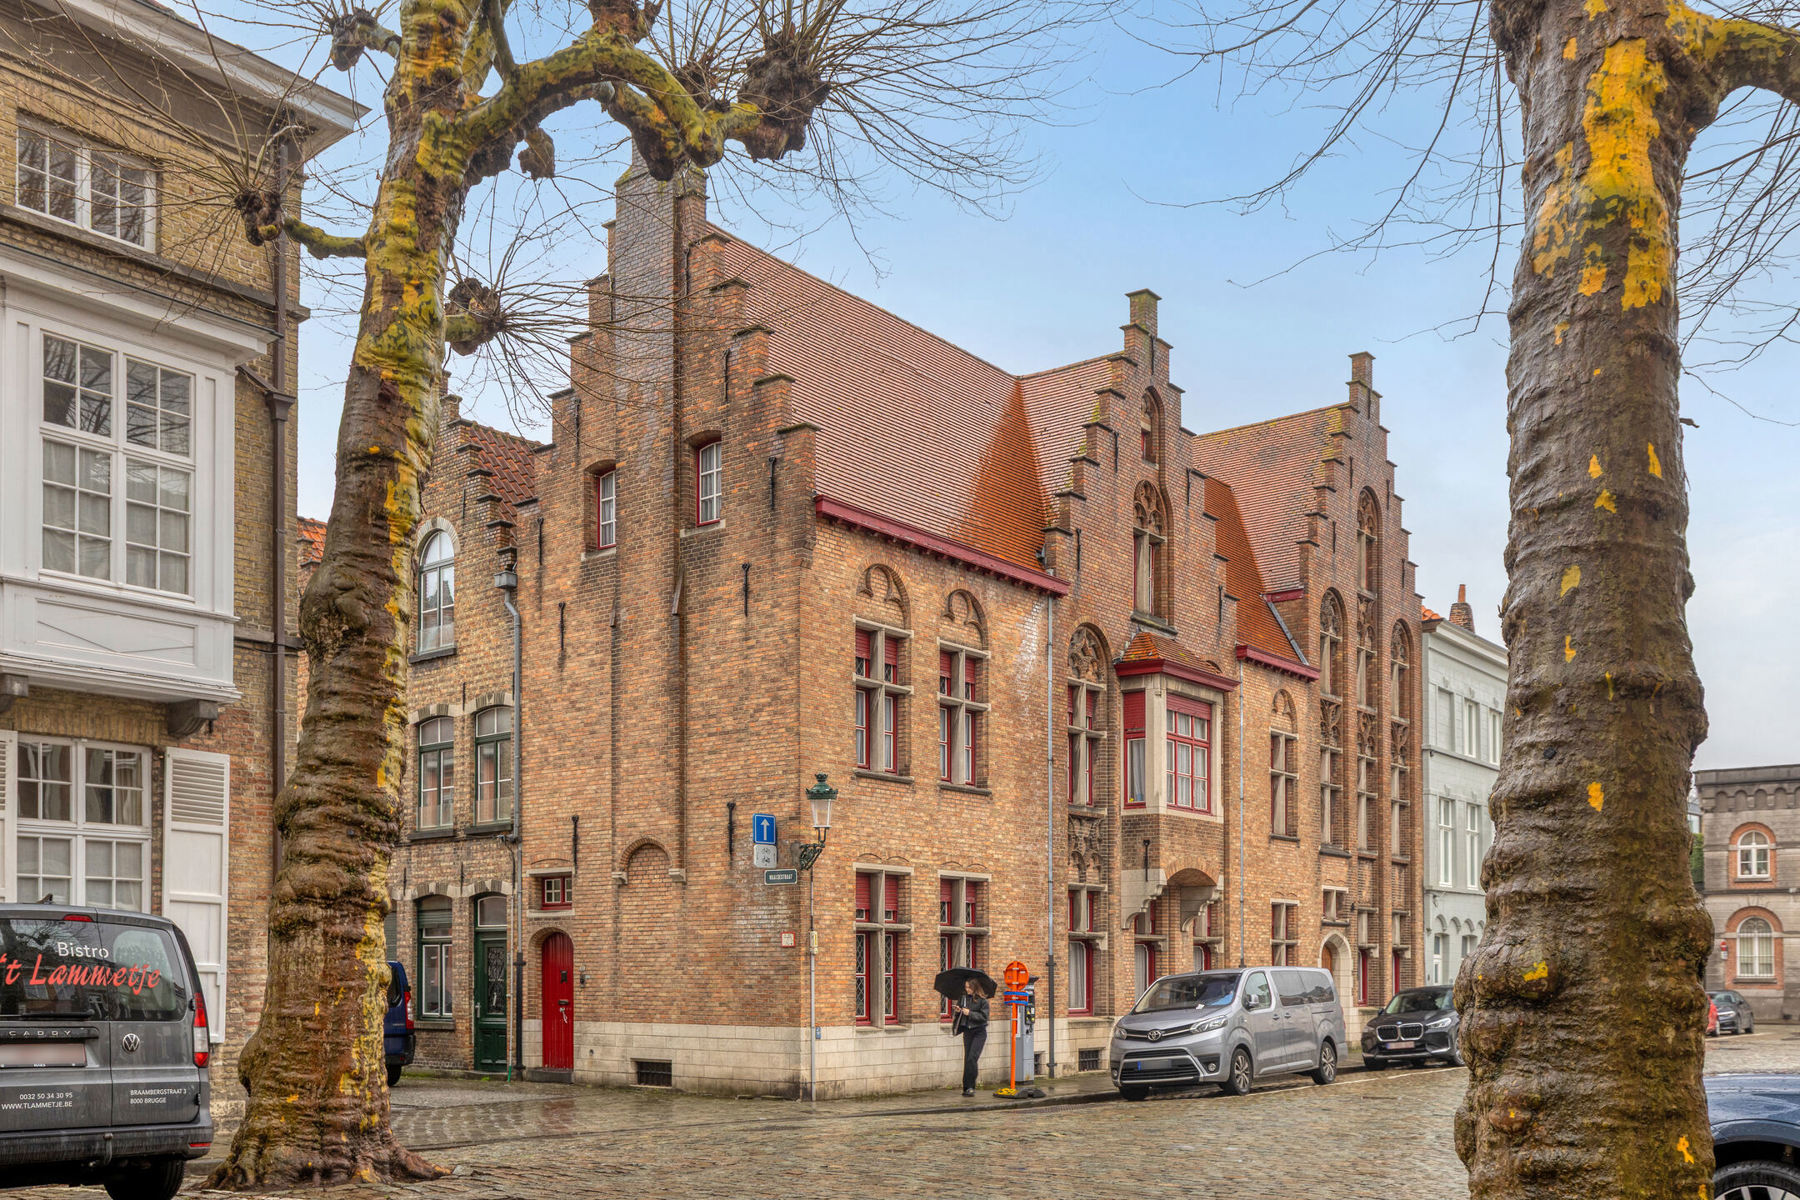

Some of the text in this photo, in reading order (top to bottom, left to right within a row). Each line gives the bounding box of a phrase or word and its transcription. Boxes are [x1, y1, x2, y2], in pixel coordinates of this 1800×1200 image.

[57, 941, 109, 959] Bistro
[29, 953, 161, 995] Lammetje
[130, 1088, 182, 1096] BRAAMBERGSTRAAT
[1, 1101, 73, 1110] WWW.TLAMMETJE.BE
